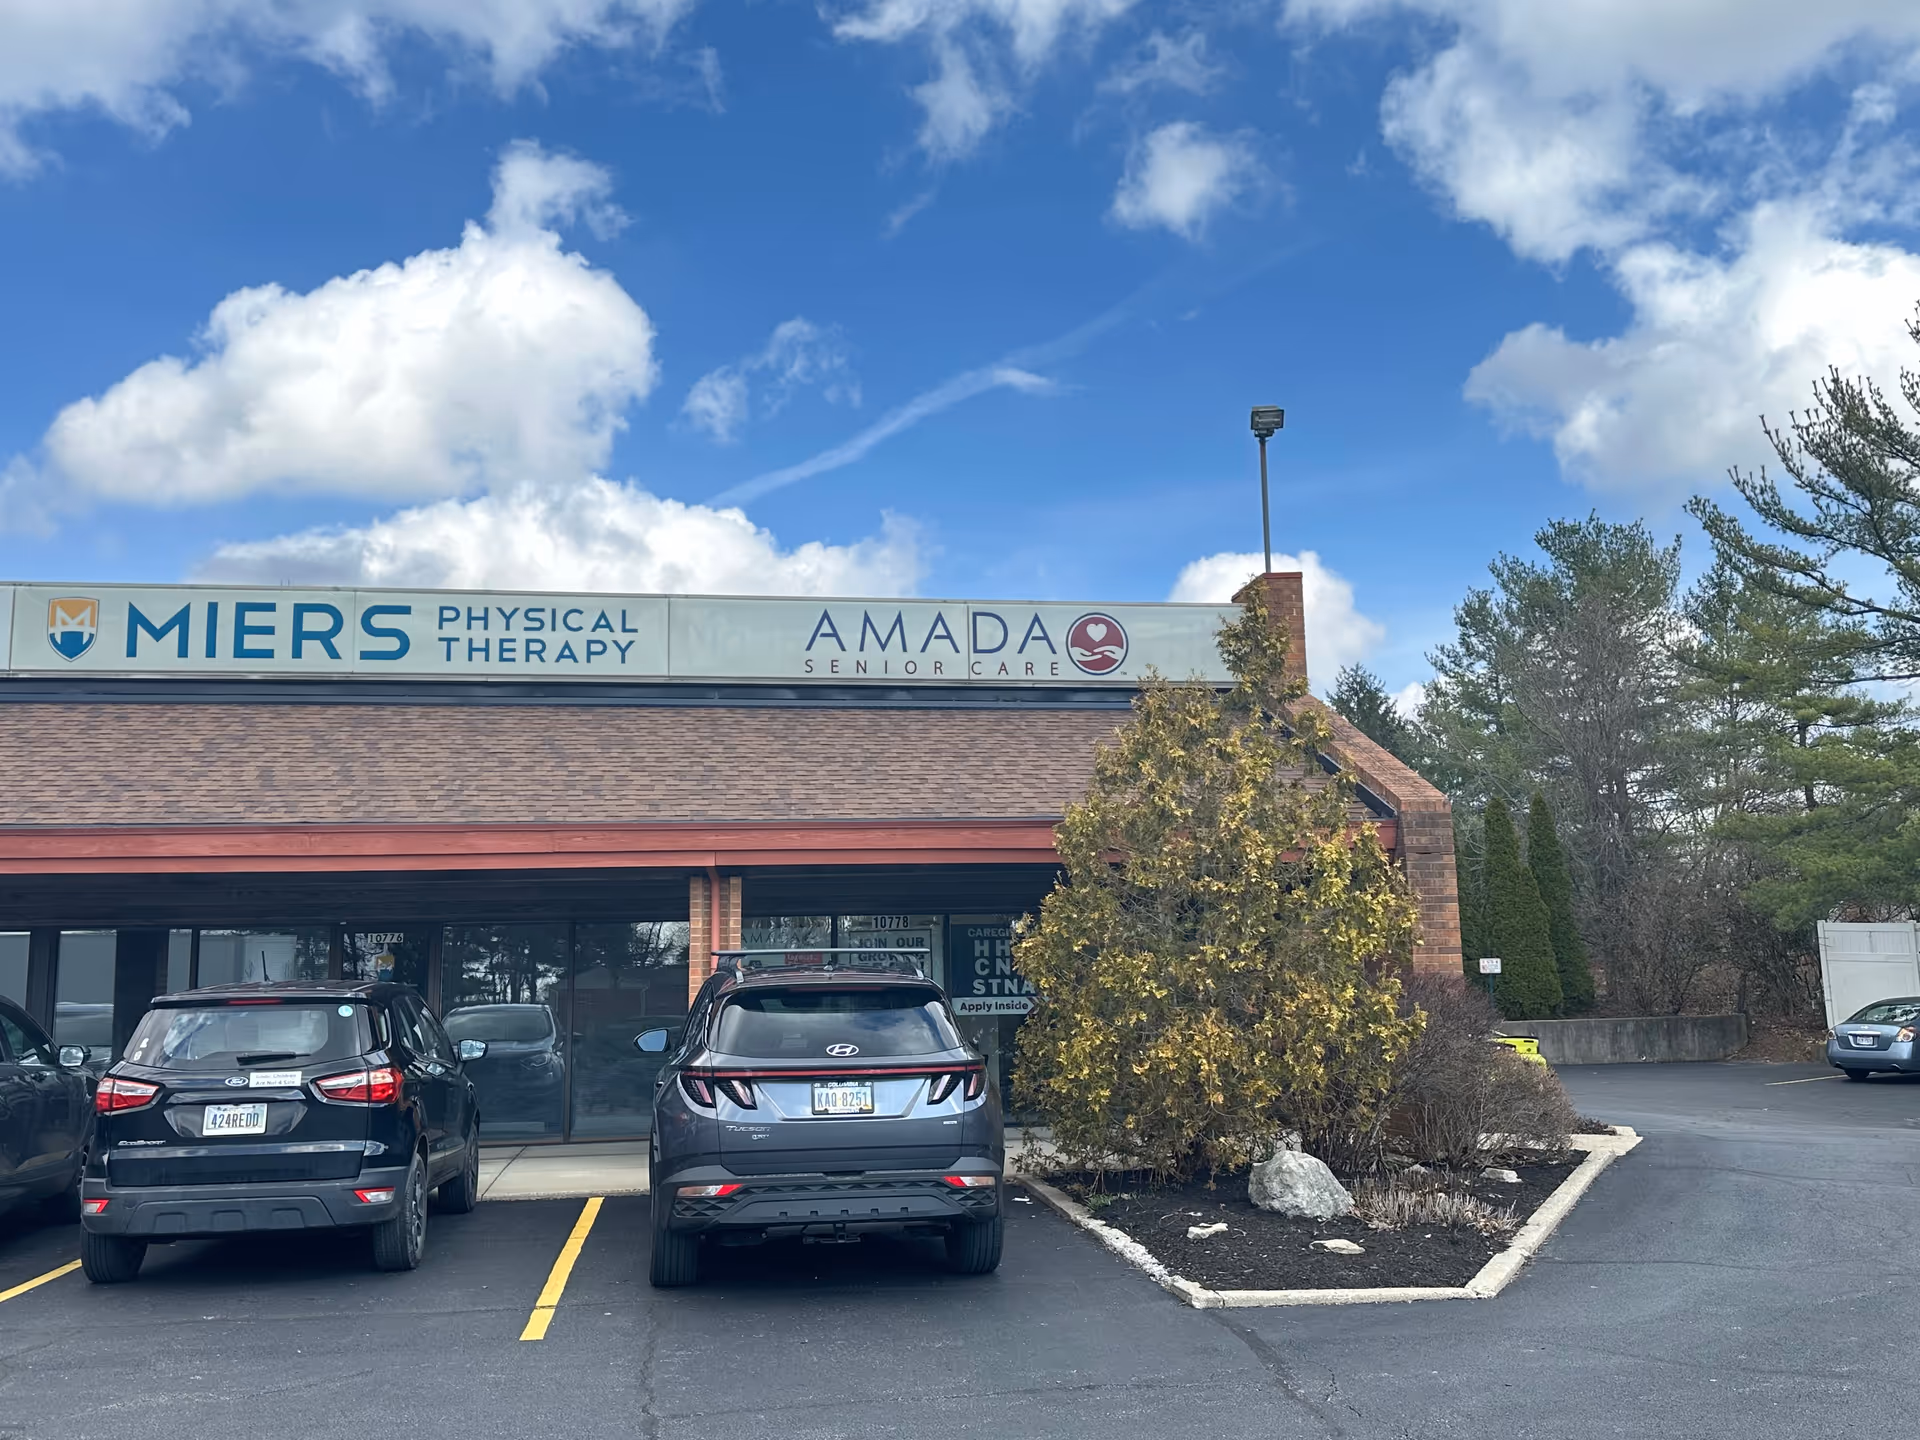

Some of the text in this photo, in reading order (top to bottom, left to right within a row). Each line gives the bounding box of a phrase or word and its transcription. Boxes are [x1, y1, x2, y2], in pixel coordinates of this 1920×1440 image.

[438, 606, 640, 634] PHYSICAL
[126, 601, 412, 661] MIERS
[804, 608, 1058, 655] AMADA
[438, 637, 637, 664] THERAPY
[804, 658, 1060, 677] SENIOR CARE
[873, 916, 909, 929] 10778
[369, 933, 403, 943] 10776
[967, 927, 1010, 938] CAREGI
[858, 936, 925, 949] JOIN OUR
[974, 939, 1011, 957] HH
[974, 957, 1011, 976] CN
[972, 978, 1036, 995] STNA
[960, 1001, 1029, 1013] Apply Inside
[841, 1091, 868, 1107] 8251
[211, 1112, 260, 1128] 424REDD
